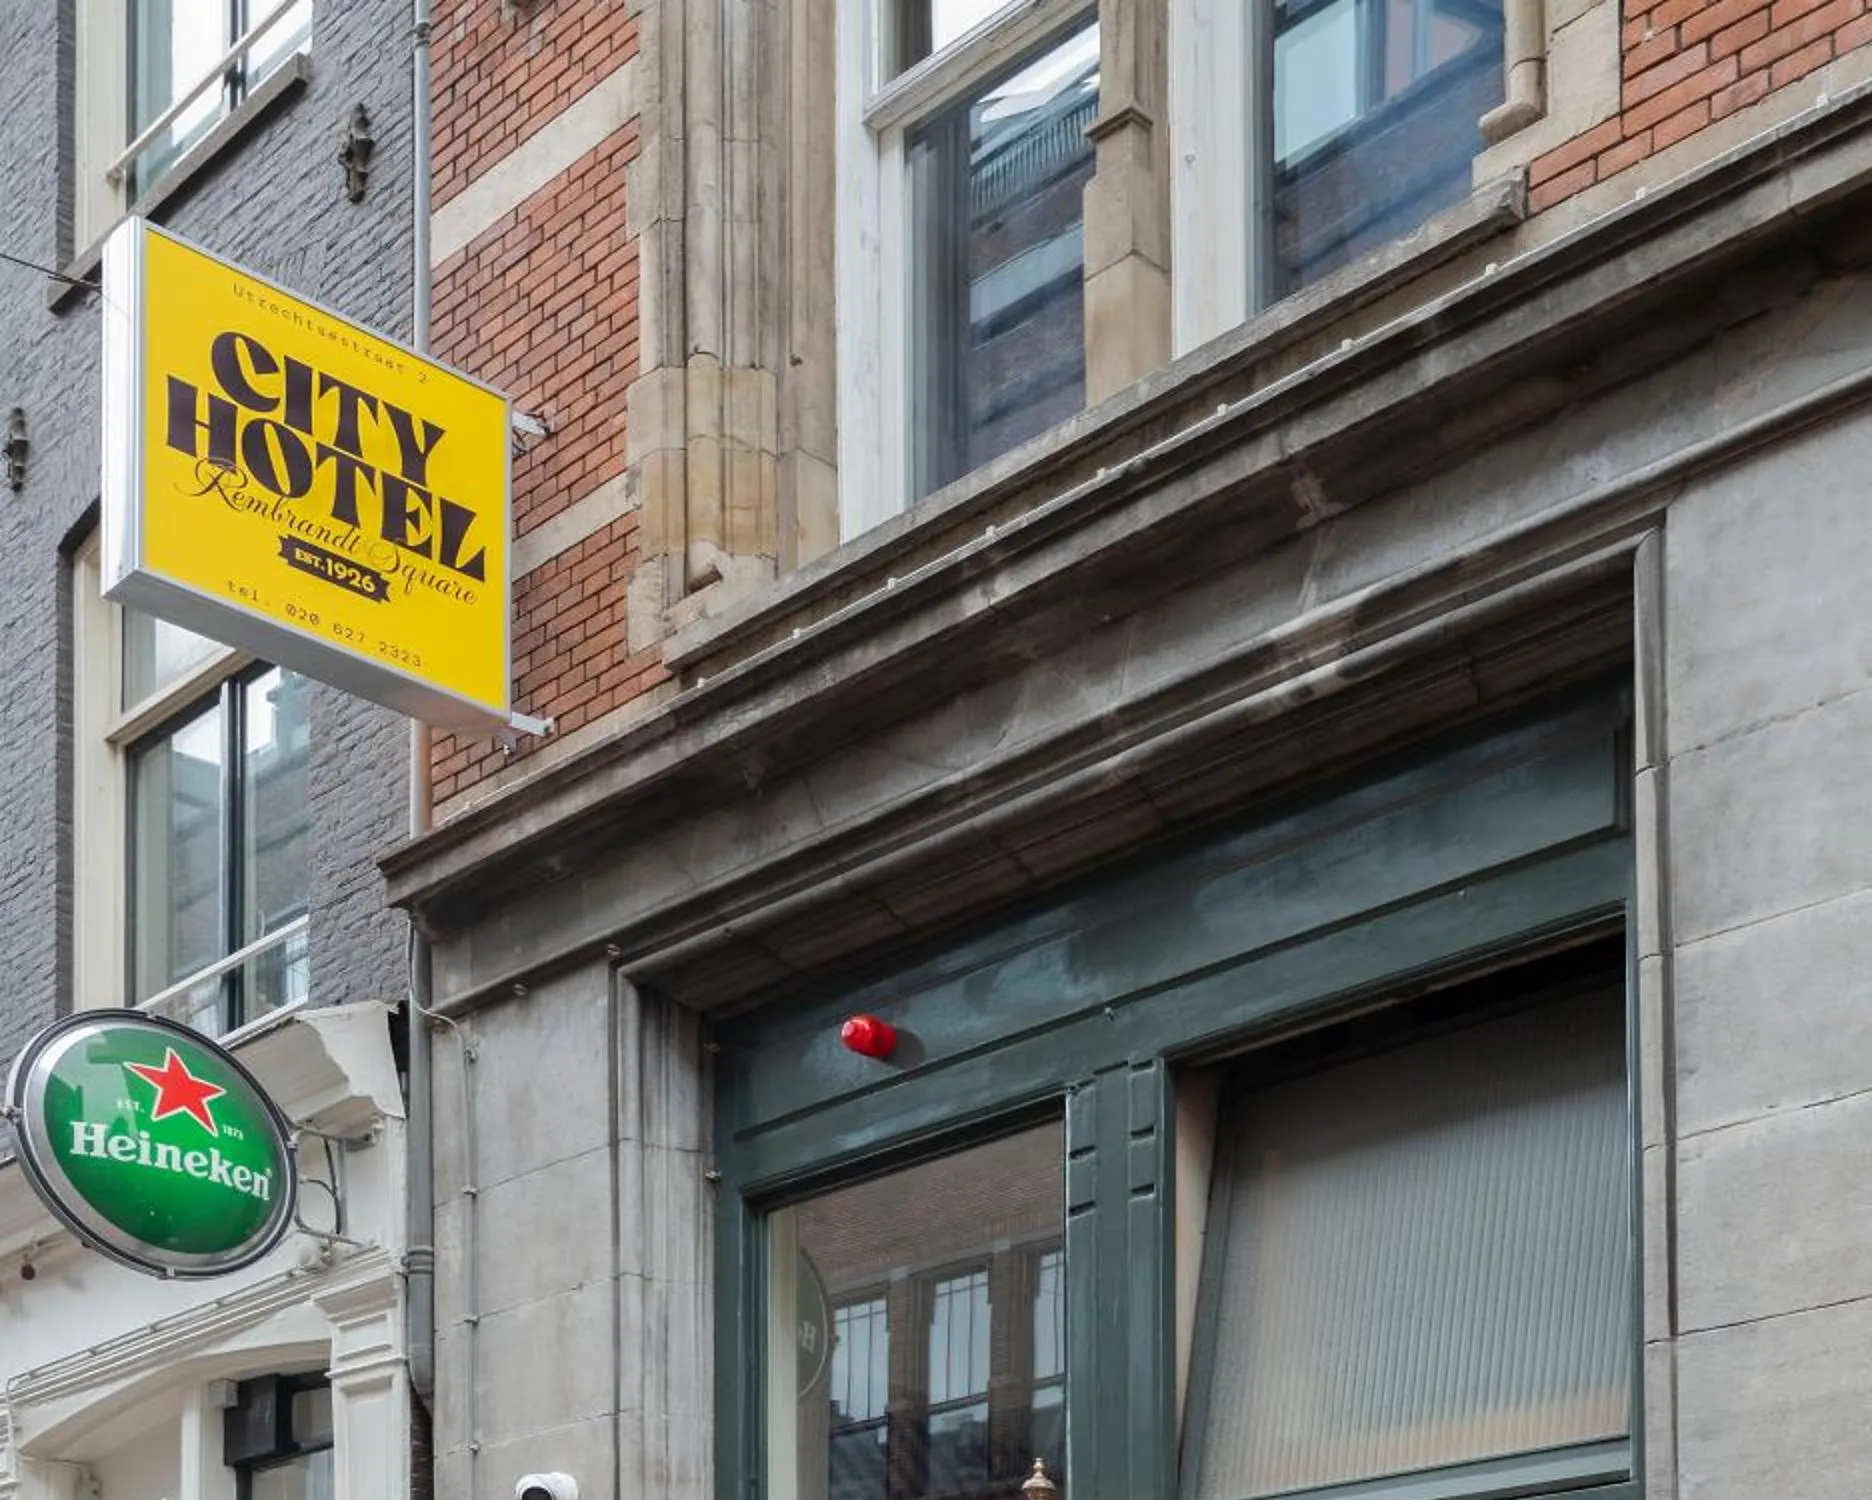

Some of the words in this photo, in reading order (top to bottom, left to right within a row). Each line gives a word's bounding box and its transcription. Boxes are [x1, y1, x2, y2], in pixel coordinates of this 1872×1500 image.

[166, 374, 486, 582] HOTEL
[211, 331, 446, 488] CITY
[173, 458, 361, 553] Rembrandt
[360, 537, 478, 606] Square
[227, 580, 270, 606] tel.
[285, 603, 320, 625] 020
[333, 623, 365, 642] 627
[379, 641, 421, 668] 2323
[69, 1120, 270, 1201] Heineken
